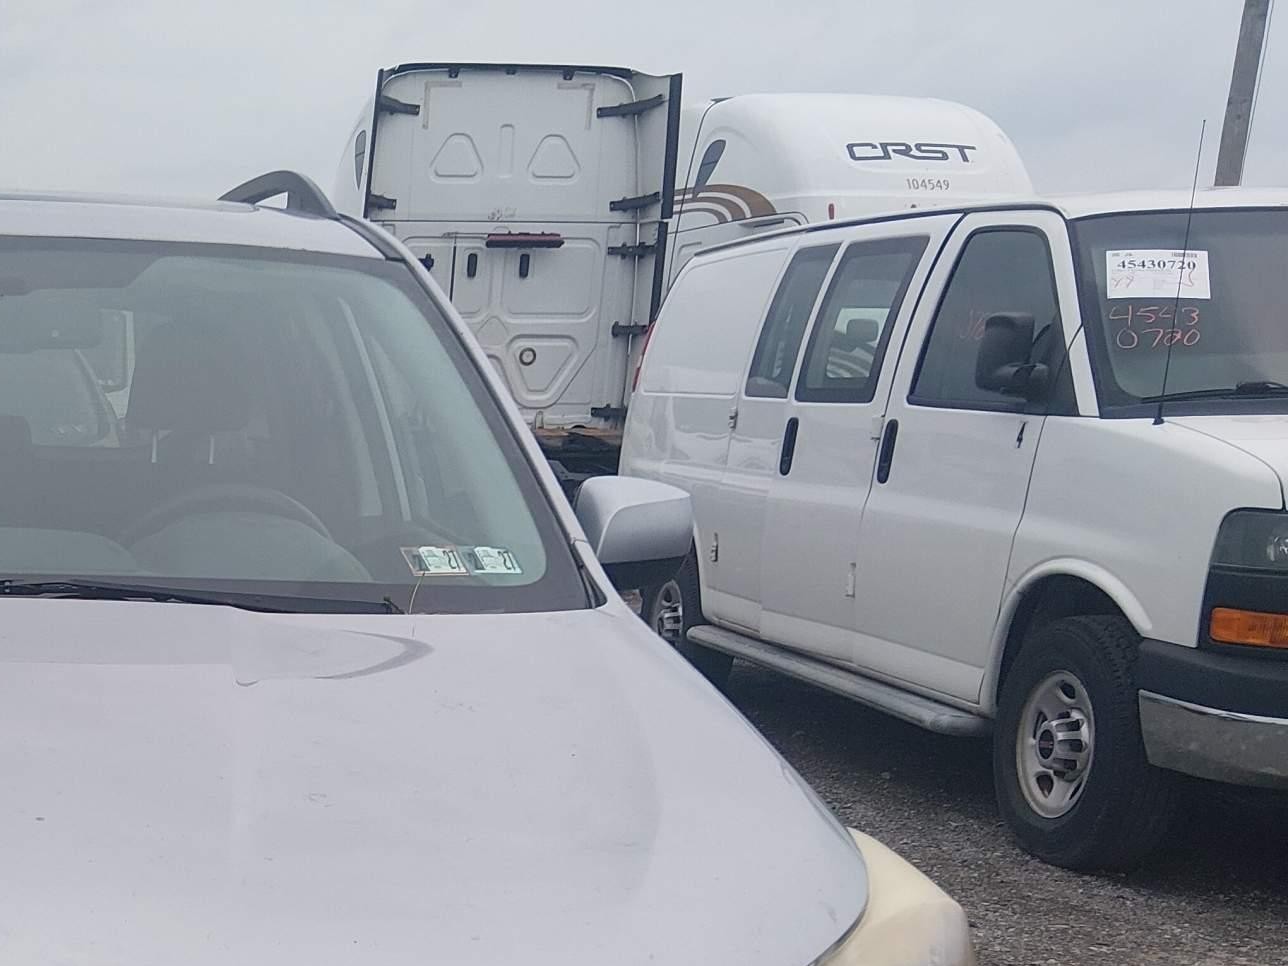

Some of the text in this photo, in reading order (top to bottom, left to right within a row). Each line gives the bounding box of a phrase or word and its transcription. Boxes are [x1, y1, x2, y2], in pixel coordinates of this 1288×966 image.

[846, 142, 977, 163] CRST
[906, 178, 950, 191] 104549
[1117, 259, 1196, 270] 45430720
